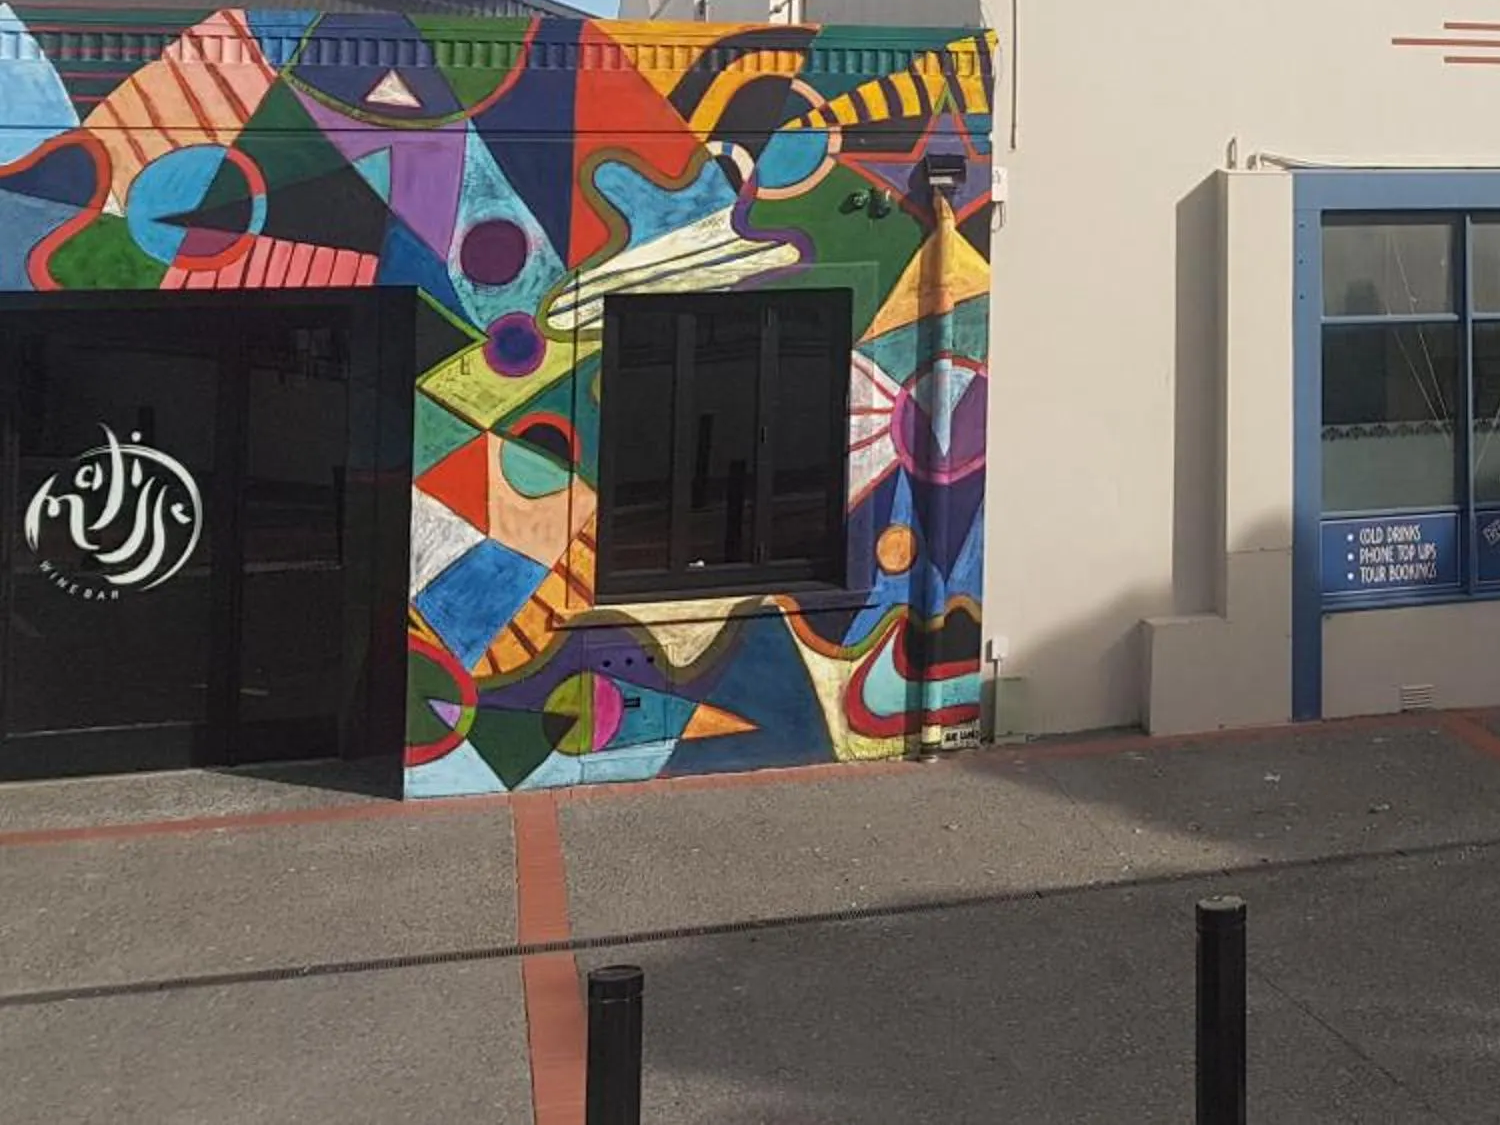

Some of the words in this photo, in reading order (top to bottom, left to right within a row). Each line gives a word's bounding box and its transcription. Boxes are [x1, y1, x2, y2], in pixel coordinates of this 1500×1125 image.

[1360, 526, 1384, 544] COLD
[1387, 524, 1421, 542] DRINKS
[1360, 545, 1394, 564] PHONE
[1396, 544, 1416, 562] TOP
[1418, 542, 1436, 560] UPS
[1360, 565, 1386, 584] TOUR
[1389, 563, 1437, 582] BOOKINGS
